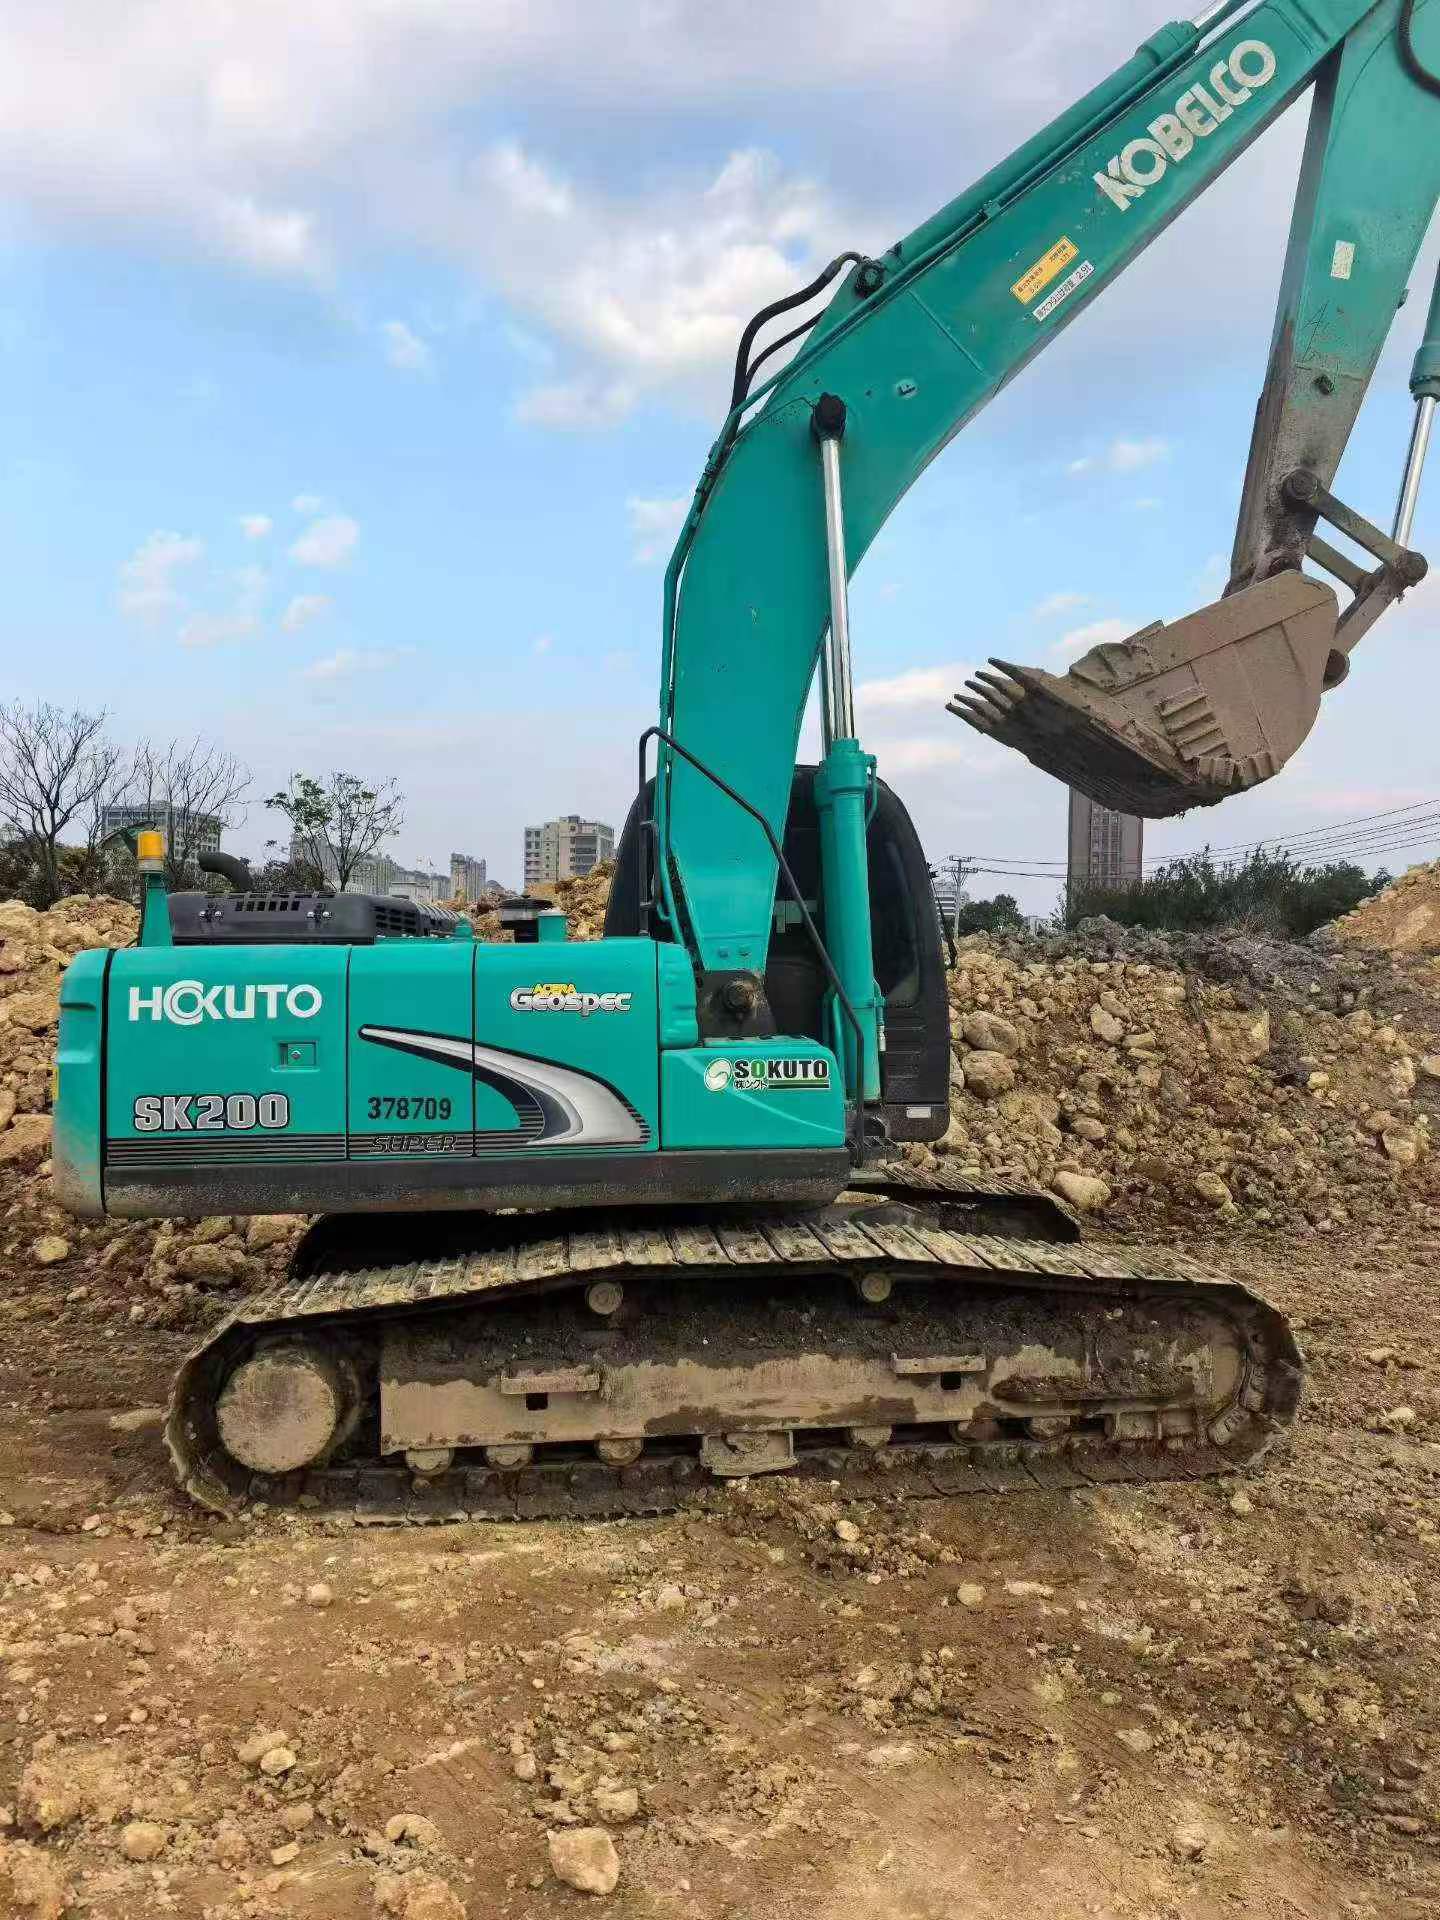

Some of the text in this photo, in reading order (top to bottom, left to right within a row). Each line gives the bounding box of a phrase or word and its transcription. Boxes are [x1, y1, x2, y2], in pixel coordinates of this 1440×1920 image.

[1093, 39, 1276, 211] KOBELCO
[128, 980, 323, 1025] HOKUTO
[734, 1059, 829, 1079] SOKUTO
[133, 1092, 291, 1133] SK200
[367, 1096, 452, 1120] 378709
[369, 1135, 457, 1153] SUPER
